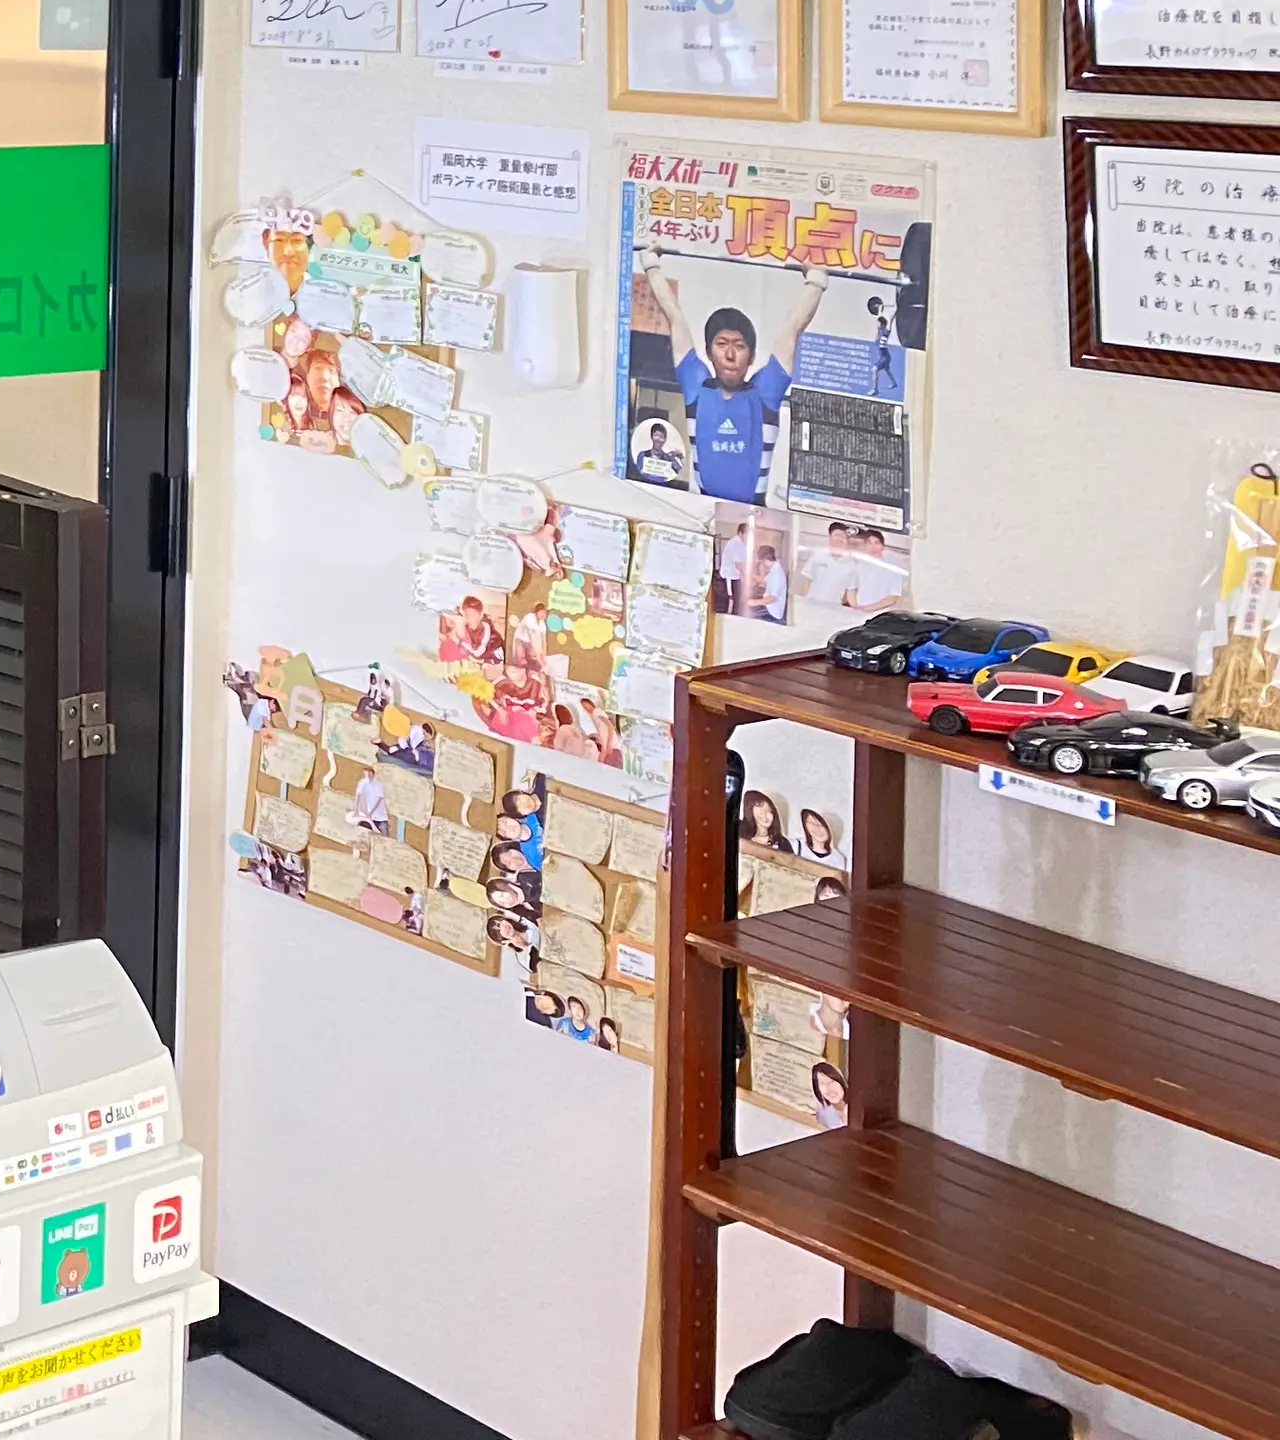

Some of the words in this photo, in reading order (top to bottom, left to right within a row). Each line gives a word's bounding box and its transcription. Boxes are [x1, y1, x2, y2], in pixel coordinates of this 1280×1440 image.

[443, 153, 488, 171] 福岡大学
[628, 153, 739, 188] 福大スポーツ
[649, 187, 723, 222] 全日本
[650, 219, 719, 244] 4年ぶり
[725, 194, 902, 271] 頂点に
[320, 252, 369, 268] ボランティア
[48, 1224, 73, 1244] LINE
[143, 1241, 191, 1269] PayPay
